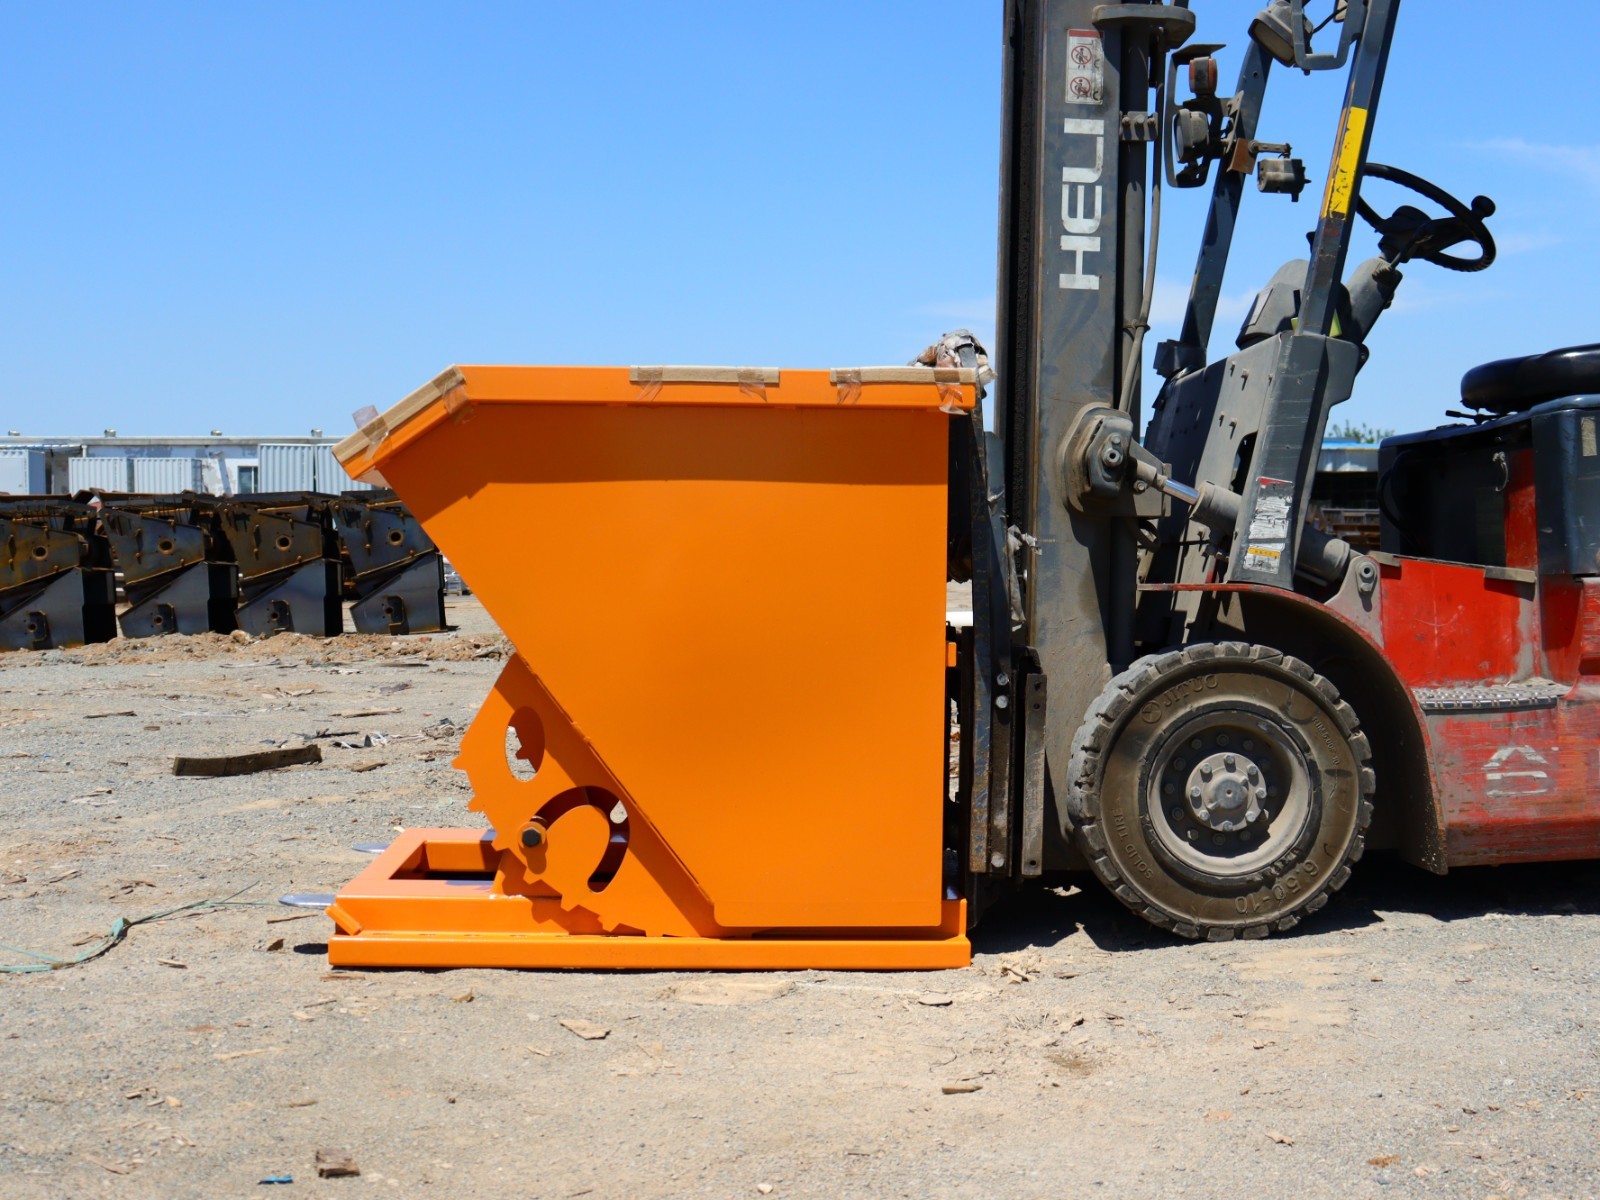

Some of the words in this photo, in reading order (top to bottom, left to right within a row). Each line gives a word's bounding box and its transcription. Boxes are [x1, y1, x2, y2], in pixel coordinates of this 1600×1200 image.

[1059, 118, 1105, 290] HELI
[1112, 807, 1129, 844] TIRE
[1122, 842, 1154, 881] SOLID
[1234, 859, 1320, 914] 6.50-10
